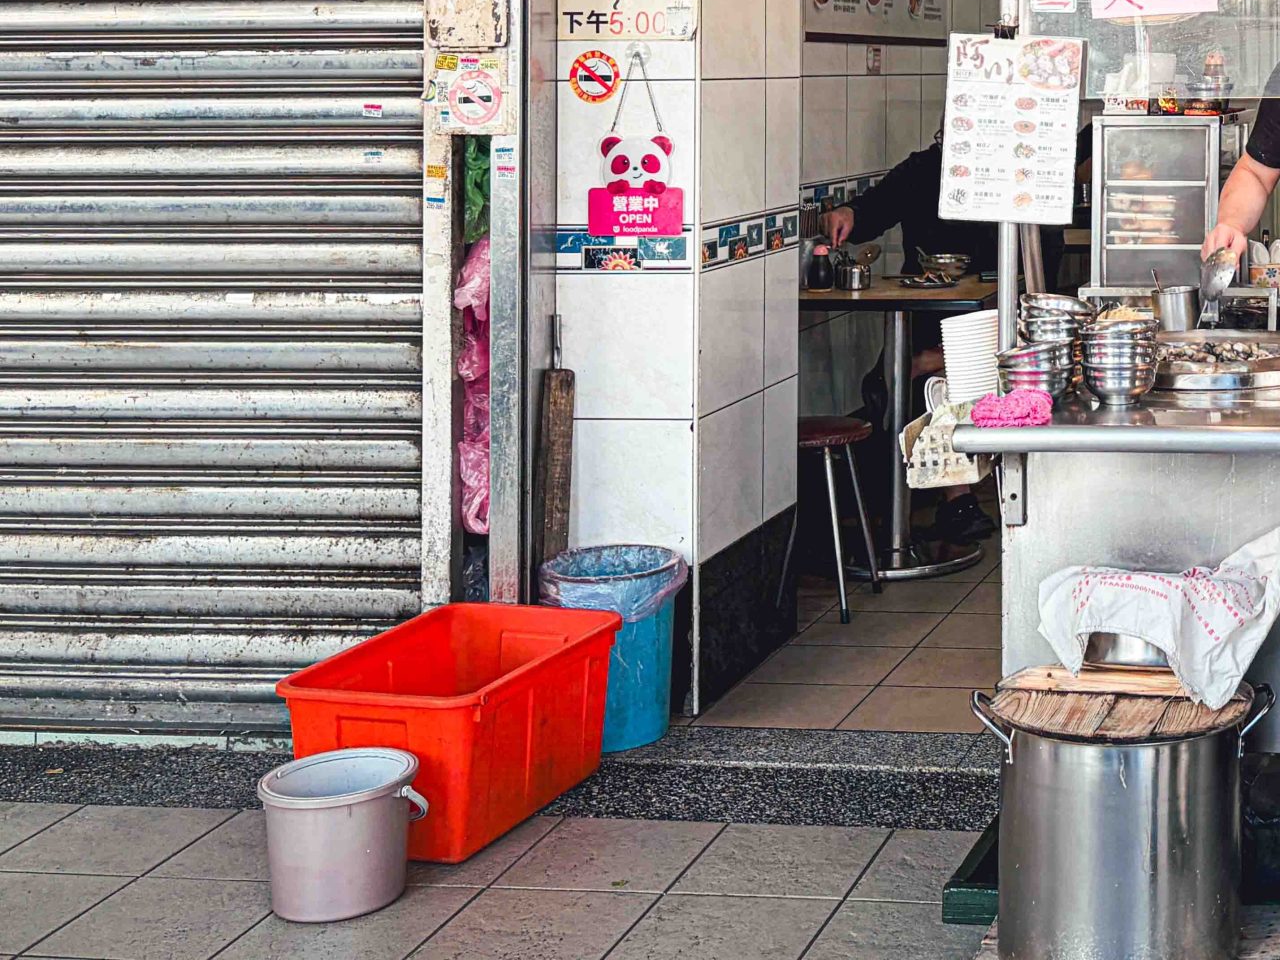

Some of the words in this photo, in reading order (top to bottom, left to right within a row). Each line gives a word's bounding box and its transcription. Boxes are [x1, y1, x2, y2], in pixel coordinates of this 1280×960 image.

[612, 195, 659, 212] 營業中
[619, 213, 653, 224] OPEN
[622, 225, 658, 234] foodpanda
